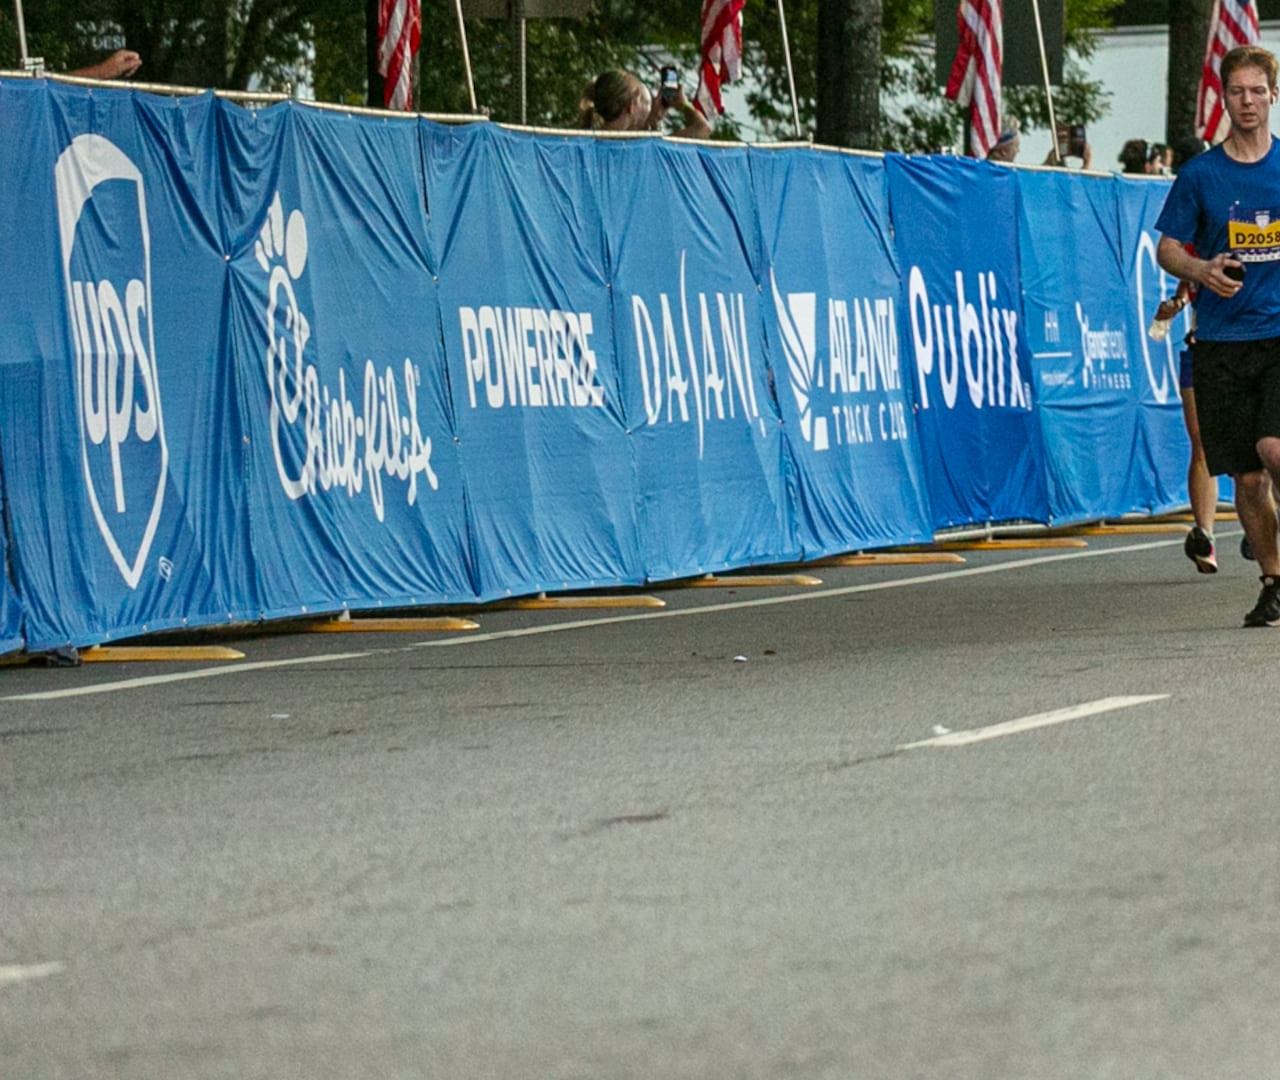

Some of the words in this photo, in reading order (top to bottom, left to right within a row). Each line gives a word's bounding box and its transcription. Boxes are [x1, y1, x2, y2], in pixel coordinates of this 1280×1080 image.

[73, 278, 158, 514] ups
[459, 305, 604, 408] POWERADE
[632, 248, 767, 460] DASANI
[909, 266, 1026, 409] Publix
